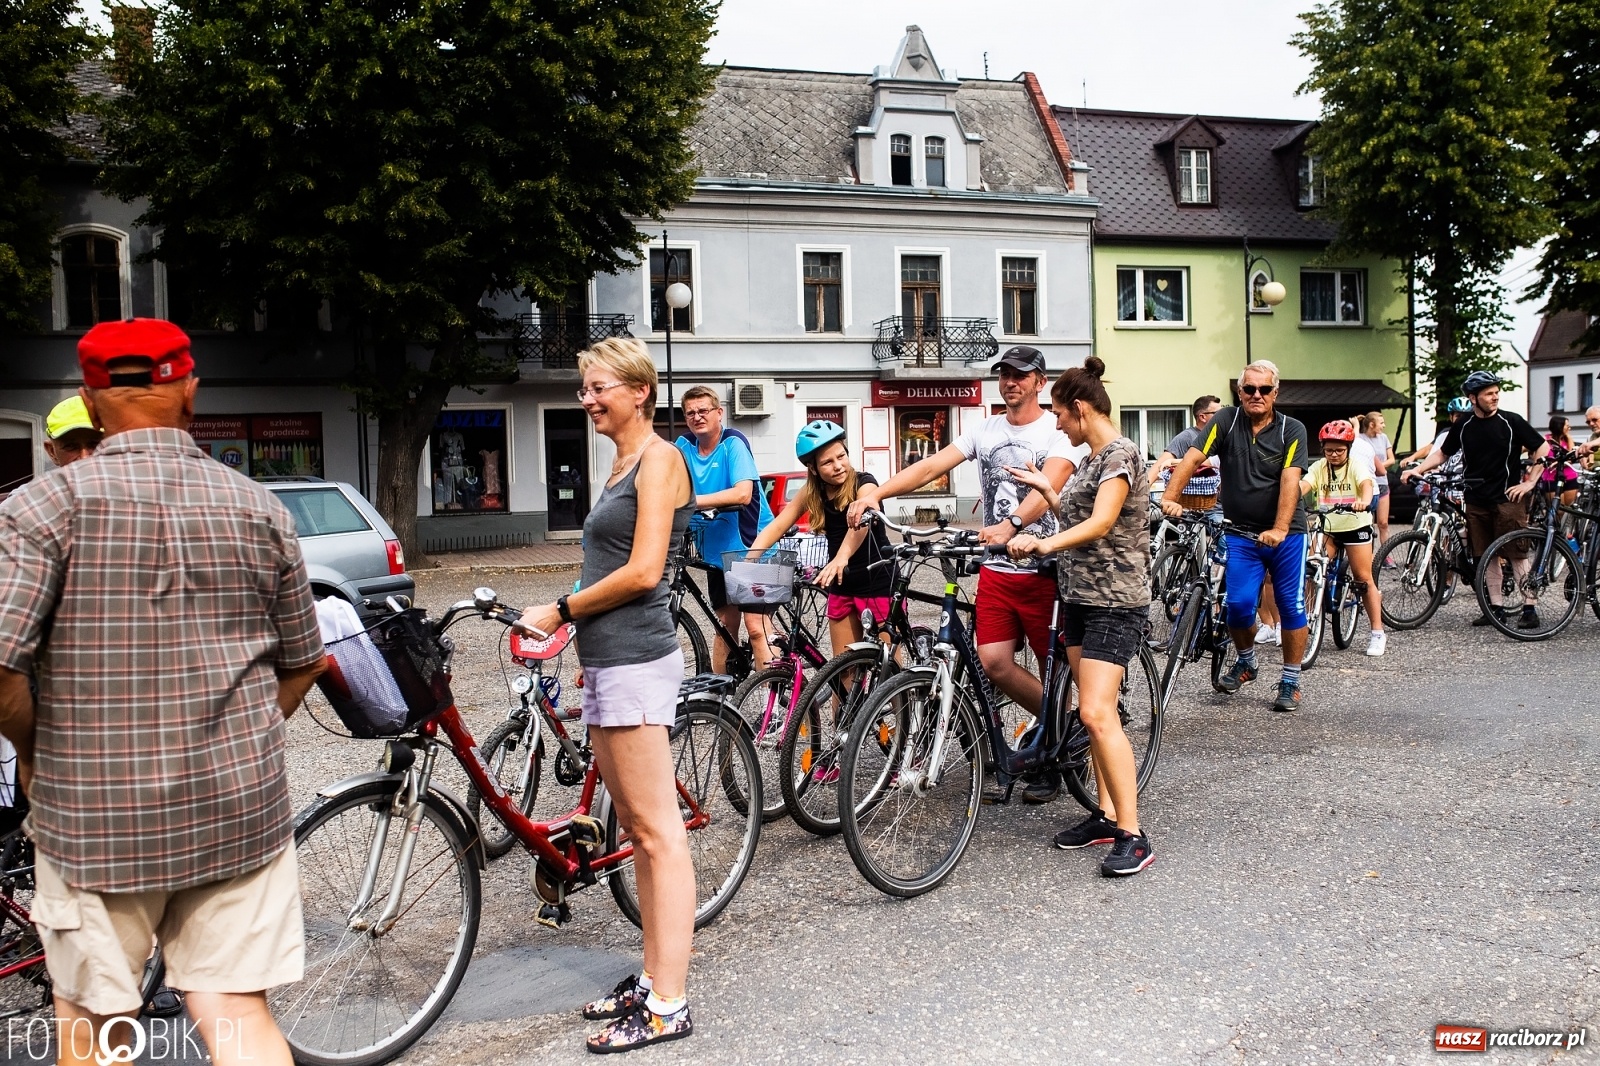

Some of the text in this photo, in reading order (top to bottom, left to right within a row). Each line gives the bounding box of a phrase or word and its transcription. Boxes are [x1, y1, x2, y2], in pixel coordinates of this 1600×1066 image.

[907, 387, 979, 398] DELIKATESY
[269, 419, 303, 427] szkolne
[191, 429, 237, 438] chemiczne
[262, 428, 310, 438] ogrodnicze
